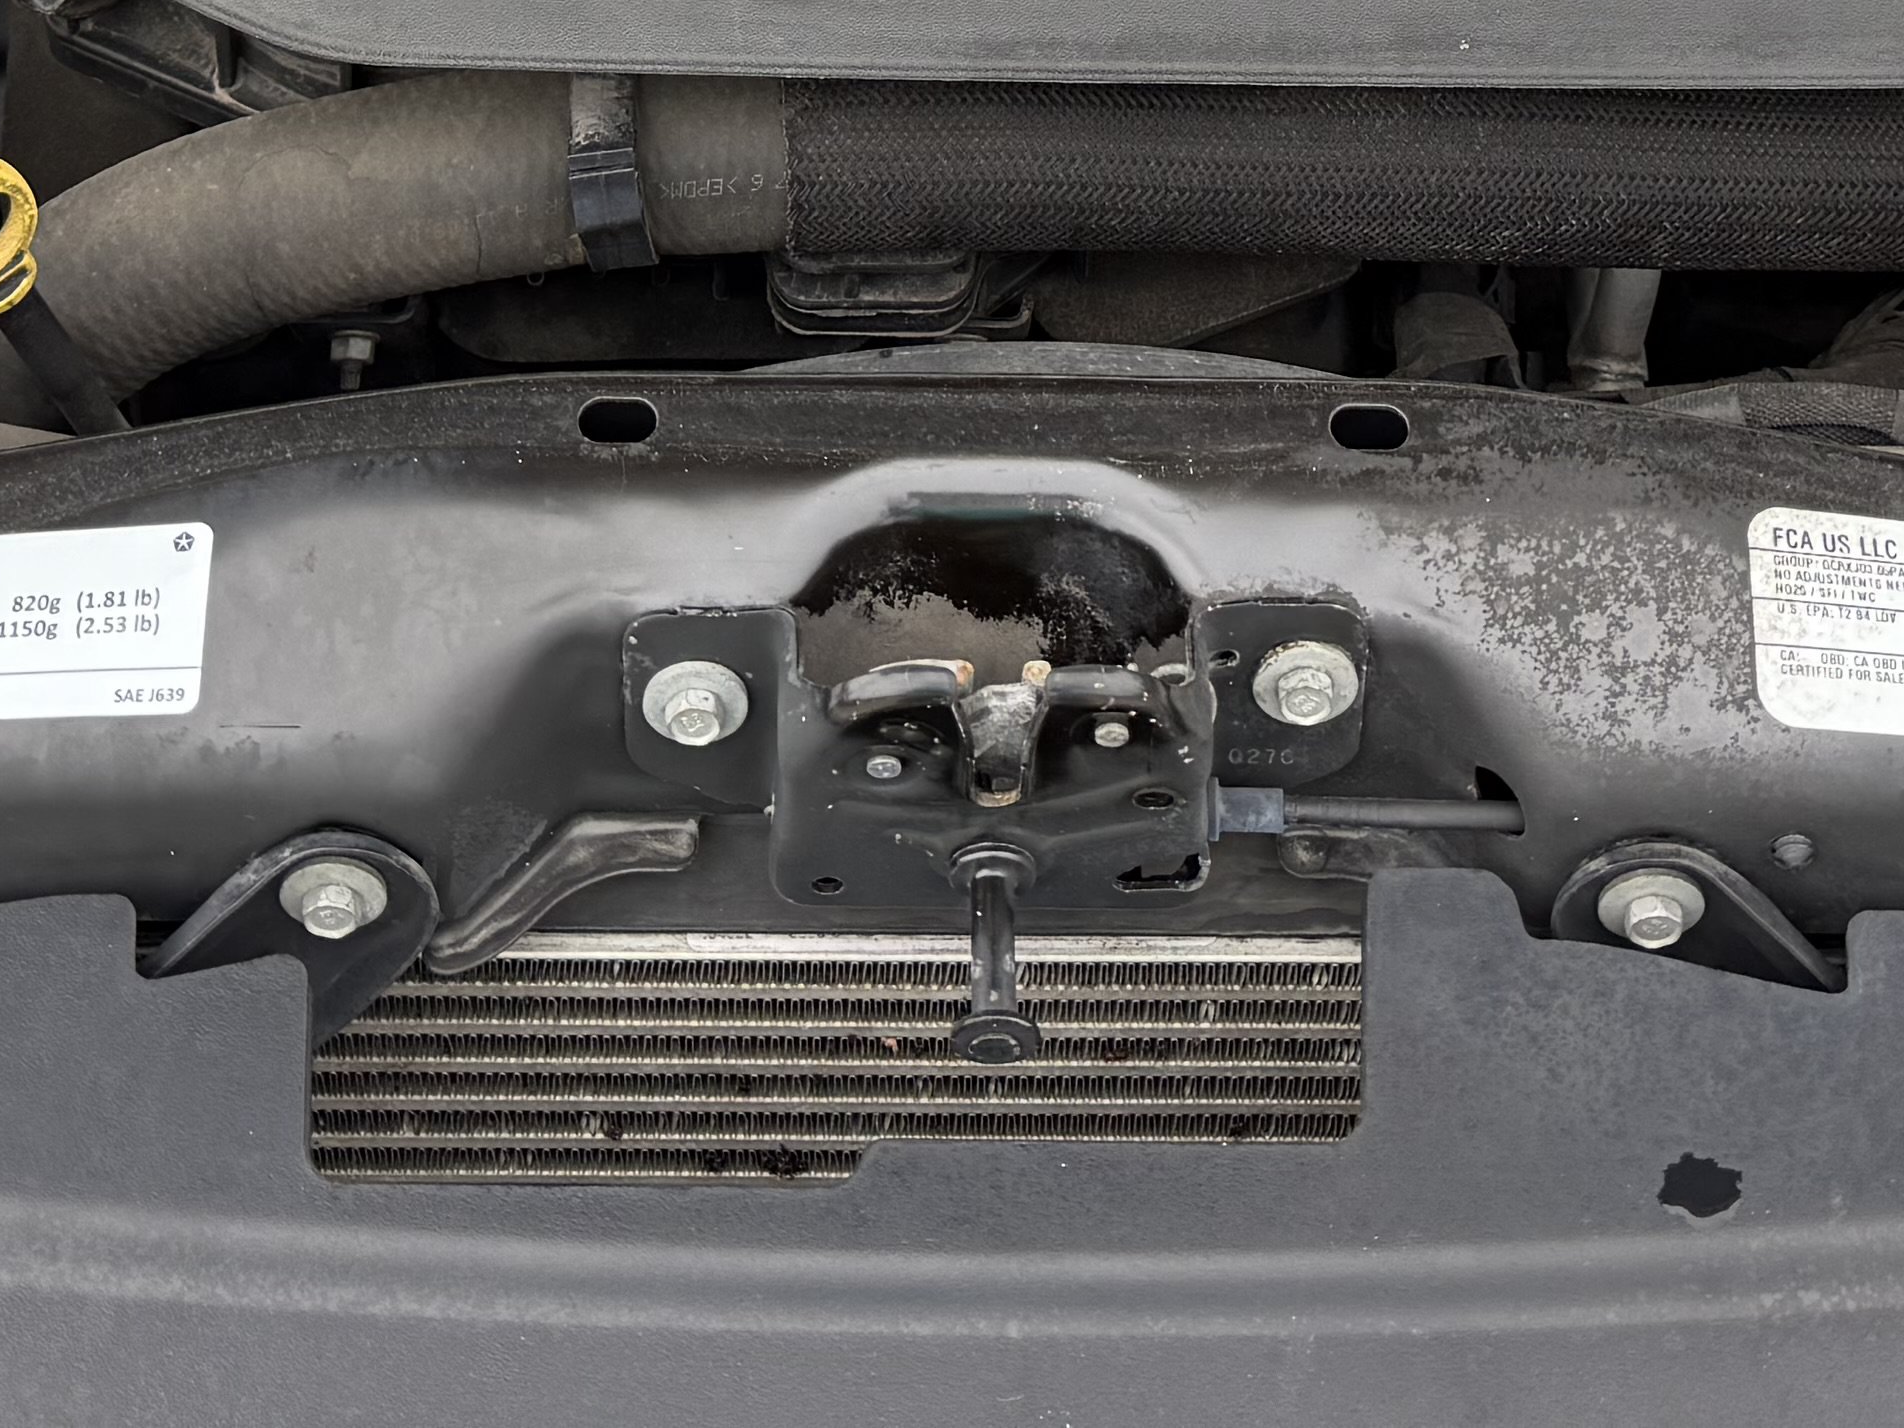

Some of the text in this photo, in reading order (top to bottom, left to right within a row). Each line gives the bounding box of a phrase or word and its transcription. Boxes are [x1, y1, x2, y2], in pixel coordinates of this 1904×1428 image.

[1772, 528, 1898, 560] FCA US LLC
[1774, 568, 1791, 580] NO
[1795, 569, 1882, 589] ADJUSTMENTS
[11, 595, 62, 615] 820g
[76, 590, 127, 613] (1.81
[134, 587, 161, 609] lb)
[75, 616, 127, 639] (2.53
[134, 613, 160, 635] lb)
[1853, 654, 1869, 667] CA
[1873, 657, 1897, 670] OBD
[1780, 663, 1844, 680] CERTIFIED
[1848, 669, 1872, 682] FOR
[1876, 672, 1904, 685] SALE
[114, 687, 186, 703] SAE J639
